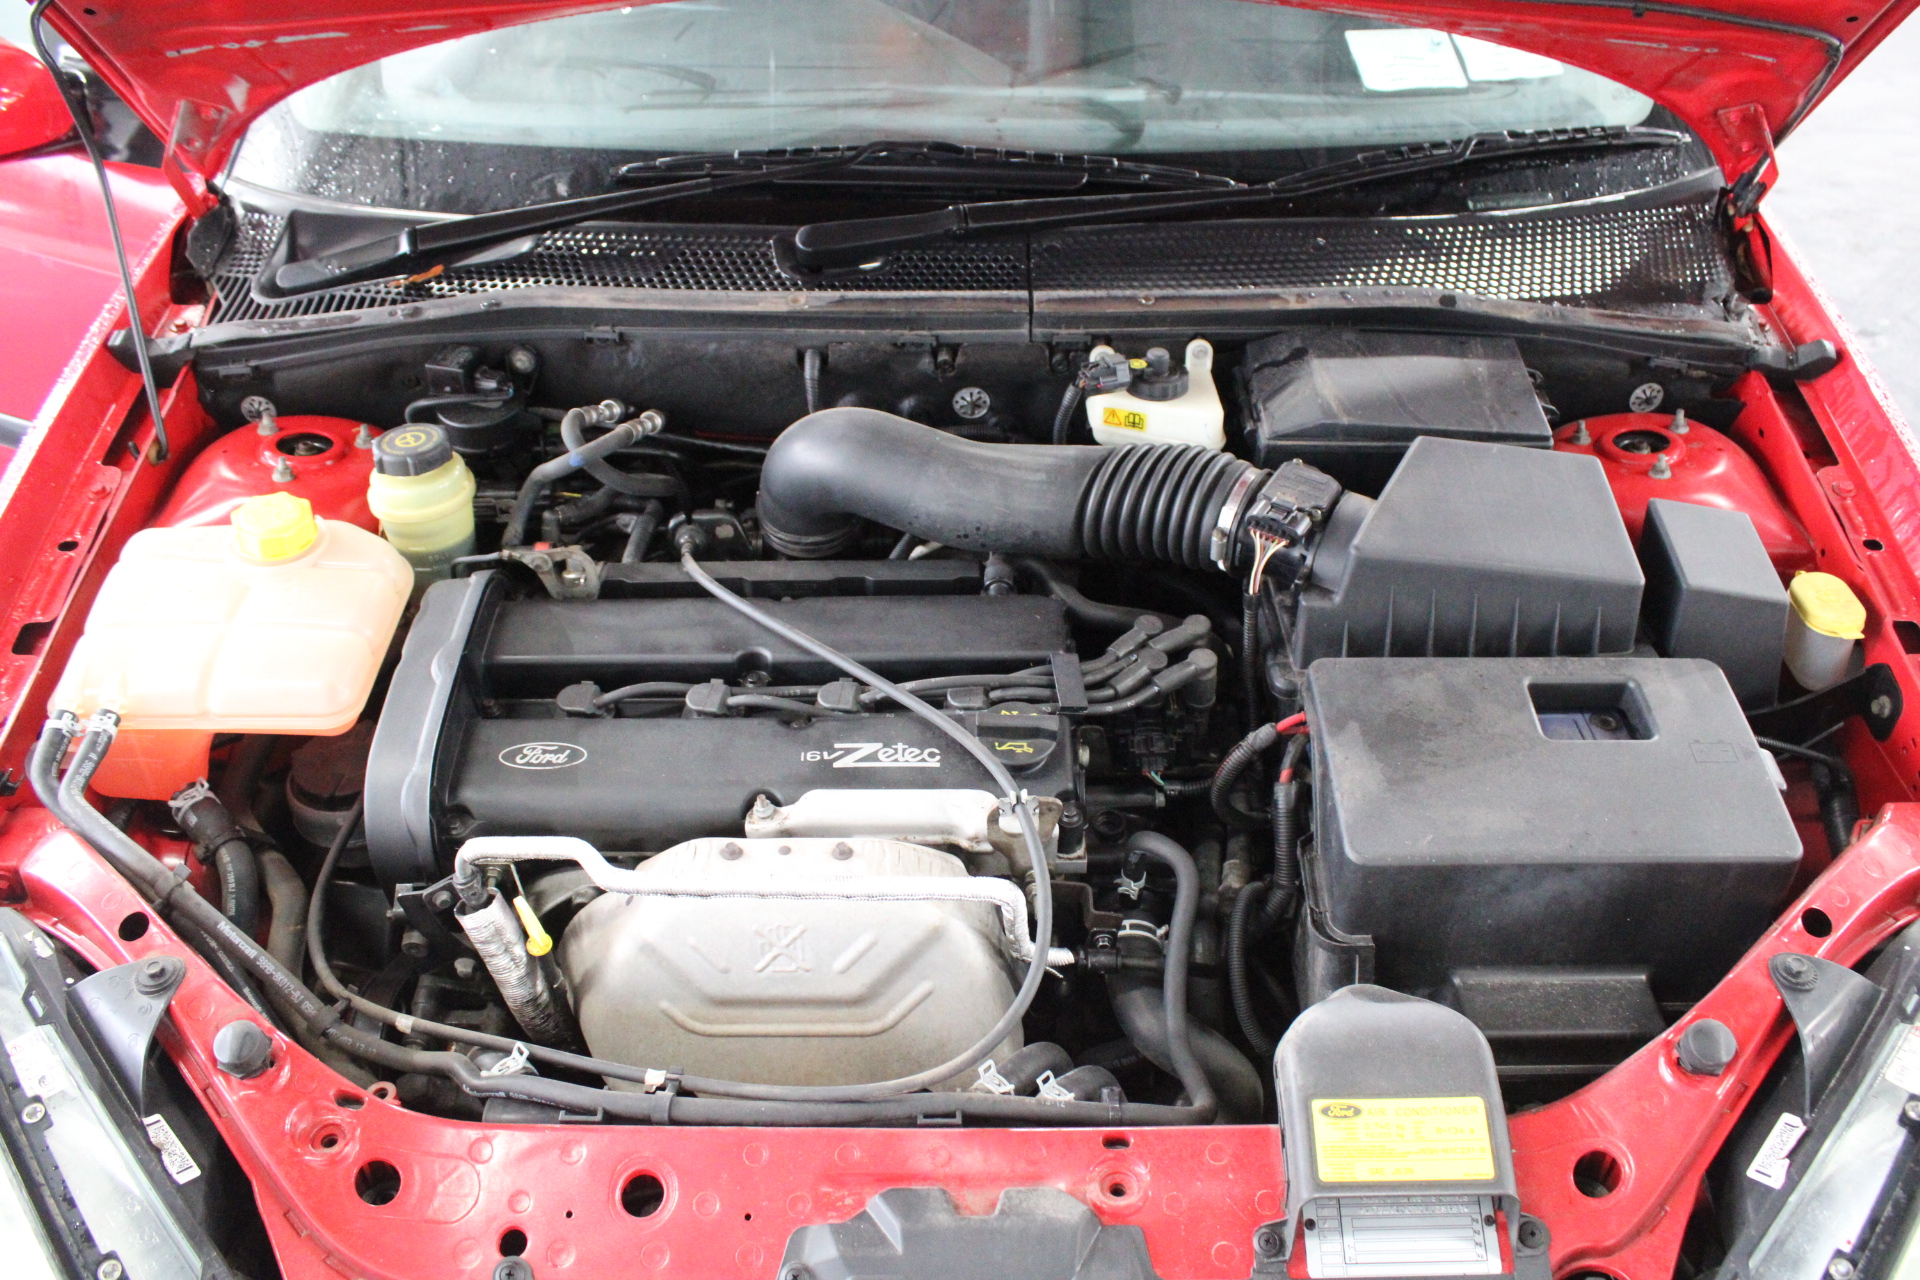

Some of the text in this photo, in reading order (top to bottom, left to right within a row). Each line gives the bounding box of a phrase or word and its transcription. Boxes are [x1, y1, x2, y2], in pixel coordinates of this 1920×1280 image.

[515, 745, 571, 765] Ford
[832, 742, 941, 769] Zetec
[216, 920, 258, 960] Motorcraft
[1367, 1107, 1387, 1117] AIR
[1395, 1105, 1479, 1117] CONDITIONER
